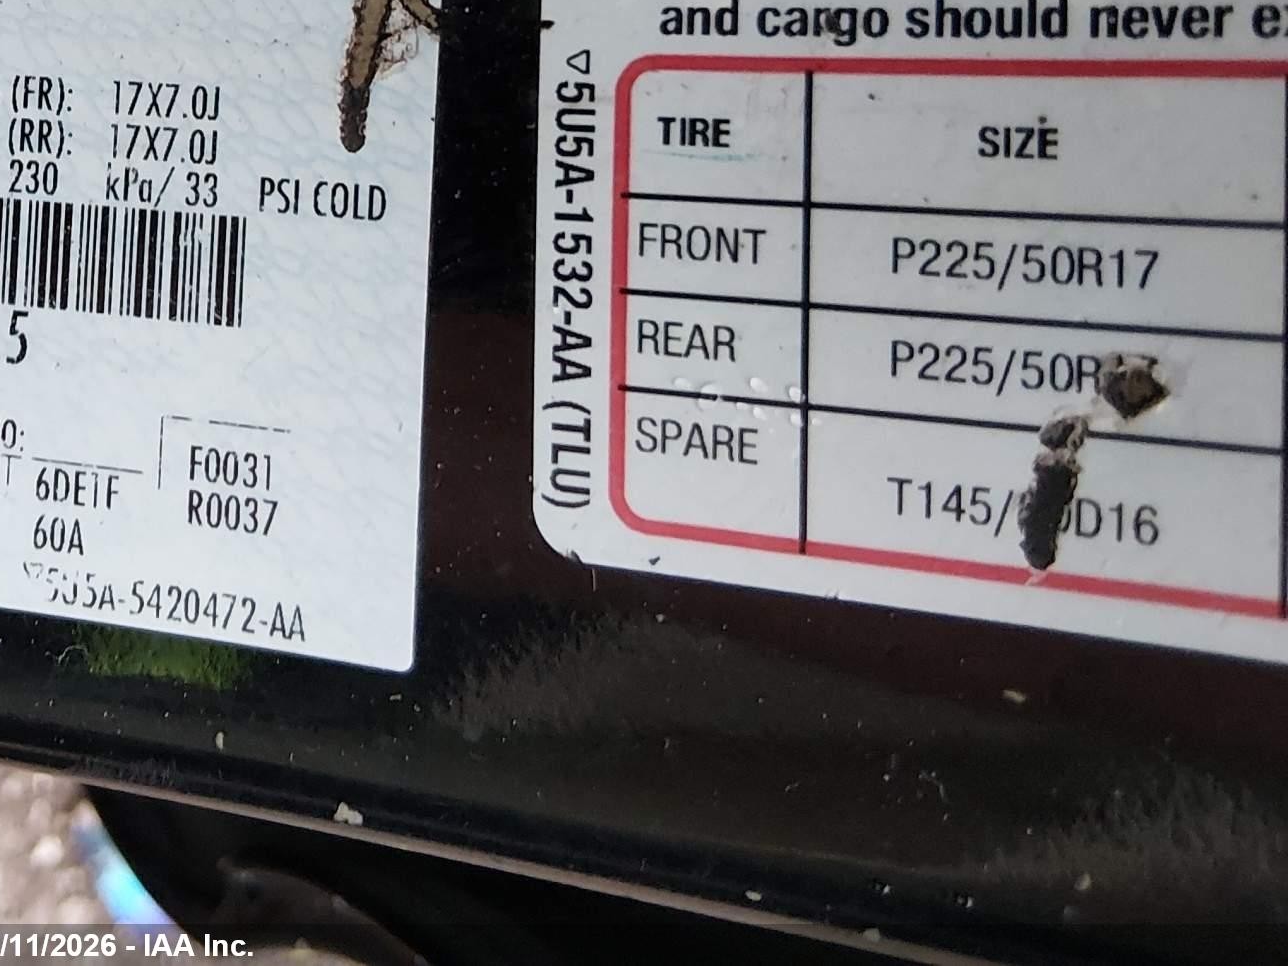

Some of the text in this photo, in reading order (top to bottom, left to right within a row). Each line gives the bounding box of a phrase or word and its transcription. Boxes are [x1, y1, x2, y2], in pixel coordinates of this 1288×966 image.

[659, 0, 740, 36] and
[757, 4, 889, 47] cargo
[1089, 3, 1234, 40] never
[12, 75, 72, 114] (FR):
[114, 80, 221, 122] 17X7.0J
[9, 118, 72, 157] (RR):
[110, 122, 219, 166] 17X7.0J
[657, 116, 731, 149] TIRE
[977, 126, 1059, 162] SIZE
[9, 160, 59, 195] 230
[105, 162, 176, 208] kPa/
[185, 172, 219, 208] 33
[259, 176, 300, 216] PSI
[312, 180, 387, 222] COLD
[637, 223, 767, 266] FRONT
[891, 237, 1160, 291] P225/50R17
[541, 80, 595, 511] 5U5A-1532-AA (TLU)
[637, 319, 737, 363] REAR
[635, 417, 759, 466] SPARE
[189, 445, 274, 491] F0031
[33, 514, 85, 556] 60A
[187, 492, 280, 537] R0037
[887, 476, 1160, 547] T145/D16
